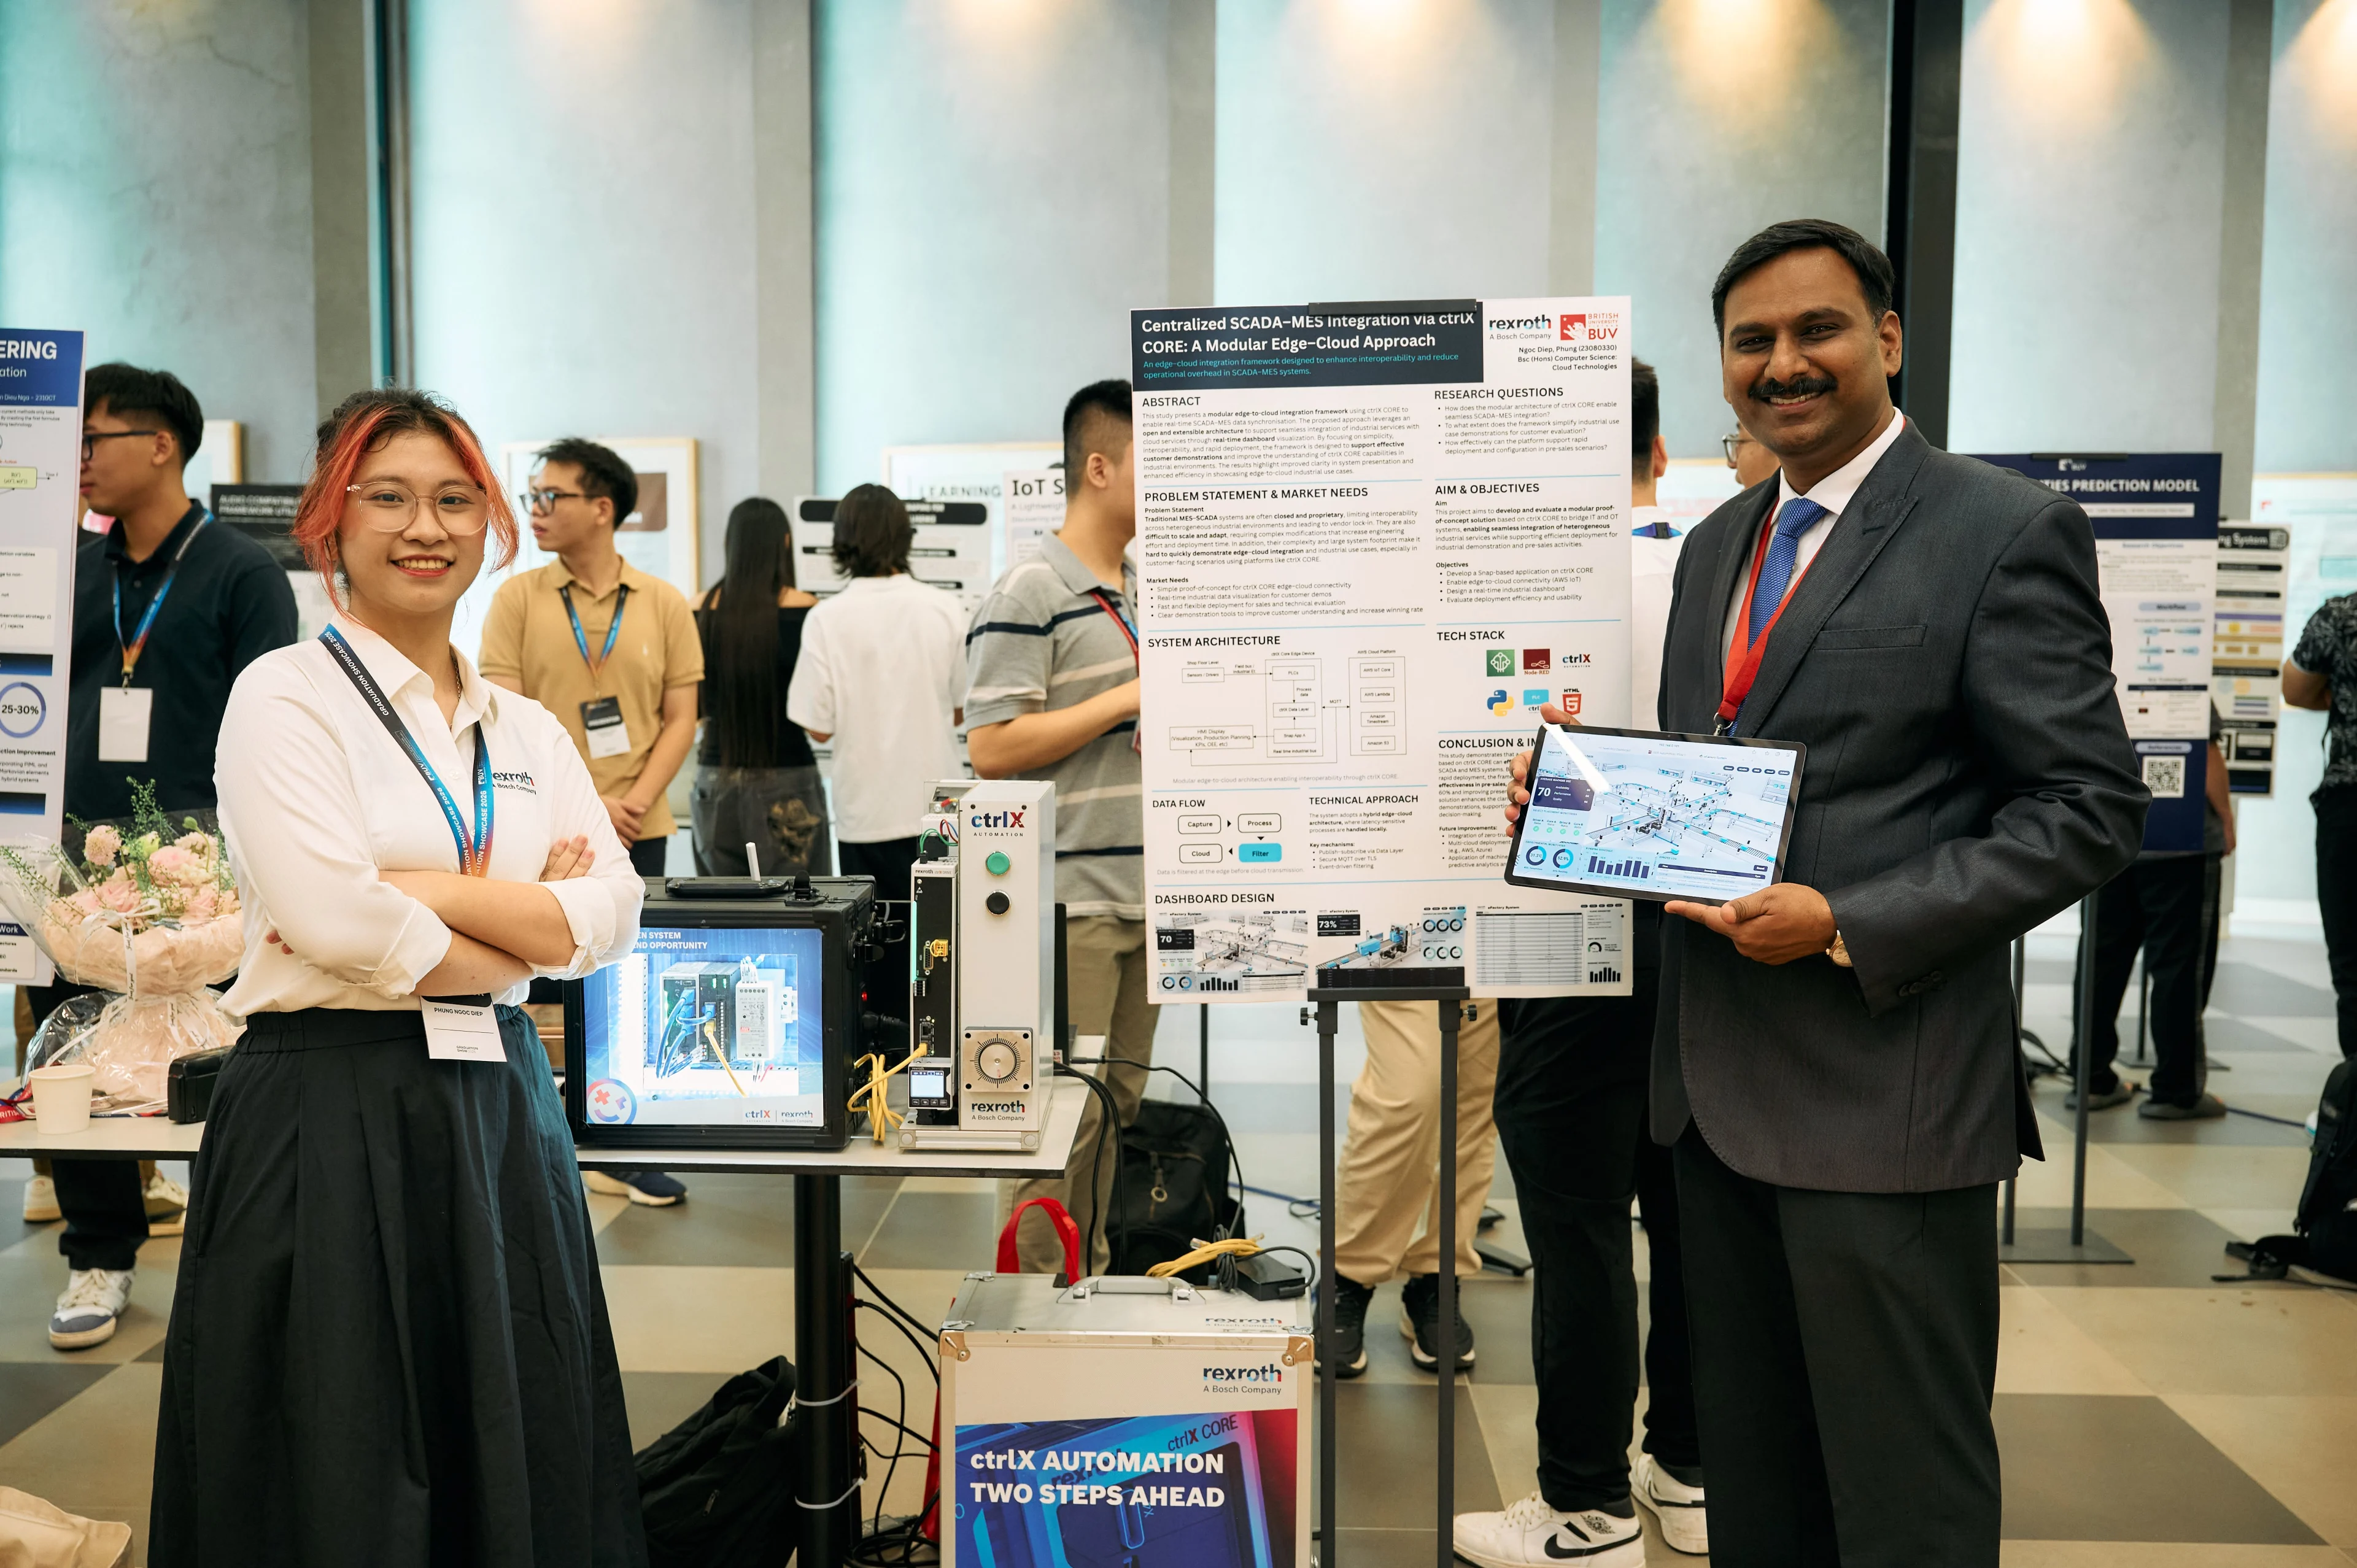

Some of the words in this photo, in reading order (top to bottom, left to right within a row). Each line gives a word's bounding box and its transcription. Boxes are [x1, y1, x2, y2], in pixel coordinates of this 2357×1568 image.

[1142, 317, 1226, 332] Centralized
[1328, 315, 1410, 330] Integration
[1414, 314, 1436, 325] via
[1439, 312, 1474, 325] ctrlX
[1489, 314, 1552, 330] rexroth
[1589, 328, 1618, 340] BUV
[1142, 340, 1188, 353] CORE:
[1191, 340, 1202, 352] A
[1206, 337, 1268, 352] Modular
[1363, 333, 1436, 351] Approach
[1199, 358, 1239, 368] integration
[1281, 357, 1315, 366] designed
[1359, 354, 1415, 363] interoperability
[1573, 363, 1617, 371] Technologies
[1144, 371, 1185, 379] operational
[1434, 389, 1494, 400] RESEARCH
[1497, 387, 1563, 400] QUESTIONS
[1142, 396, 1201, 407] ABSTRACT
[921, 485, 1001, 497] LEARNING
[1013, 479, 1045, 496] IoT
[1435, 485, 1457, 495] AIM
[1460, 485, 1467, 494] &
[1470, 483, 1539, 494] OBJECTIVES
[2072, 479, 2150, 492] PREDICTION
[2153, 479, 2200, 492] MODEL
[1145, 492, 1199, 502] PROBLEM
[1202, 490, 1268, 501] STATEMENT
[1271, 490, 1279, 499] &
[1281, 489, 1328, 498] MARKET
[1331, 487, 1368, 497] NEEDS
[2232, 532, 2268, 548] System
[324, 631, 337, 643] 2026
[1148, 638, 1191, 647] SYSTEM
[1194, 636, 1280, 646] ARCHITECTURE
[1436, 631, 1466, 641] TECH
[1469, 630, 1505, 640] STACK
[332, 641, 361, 675] SHOWCASE
[1562, 654, 1591, 663] ctrlX
[357, 674, 389, 716] GRADUATION
[1, 705, 39, 715] 25-30%
[1566, 697, 1578, 712] 5
[1438, 738, 1514, 749] CONCLUSION
[1517, 738, 1525, 747] &
[418, 762, 431, 777] BUV
[492, 771, 535, 787] exroth
[437, 787, 450, 805] 2026
[517, 784, 536, 795] Company
[1537, 787, 1551, 797] 70
[1152, 800, 1177, 808] DATA
[1179, 799, 1206, 808] FLOW
[1309, 796, 1364, 805] TECHNICAL
[1366, 795, 1418, 804] APPROACH
[971, 811, 1025, 828] ctrlX
[447, 805, 468, 848] SHOWCASE
[479, 808, 488, 850] SHOWCASE
[1155, 894, 1228, 904] DASHBOARD
[1231, 893, 1274, 903] DESIGN
[972, 1100, 1025, 1113] rexroth
[745, 1110, 770, 1118] ctrlX
[1203, 1363, 1282, 1382] rexroth
[1241, 1386, 1282, 1395] Company
[1167, 1428, 1200, 1452] ctrlX
[1201, 1414, 1239, 1440] CORE
[970, 1449, 1036, 1471] ctrlX
[1042, 1451, 1224, 1474] AUTOMATION
[970, 1482, 1033, 1504] TWO
[1039, 1484, 1124, 1506] STEPS
[1129, 1485, 1226, 1507] AHEAD
